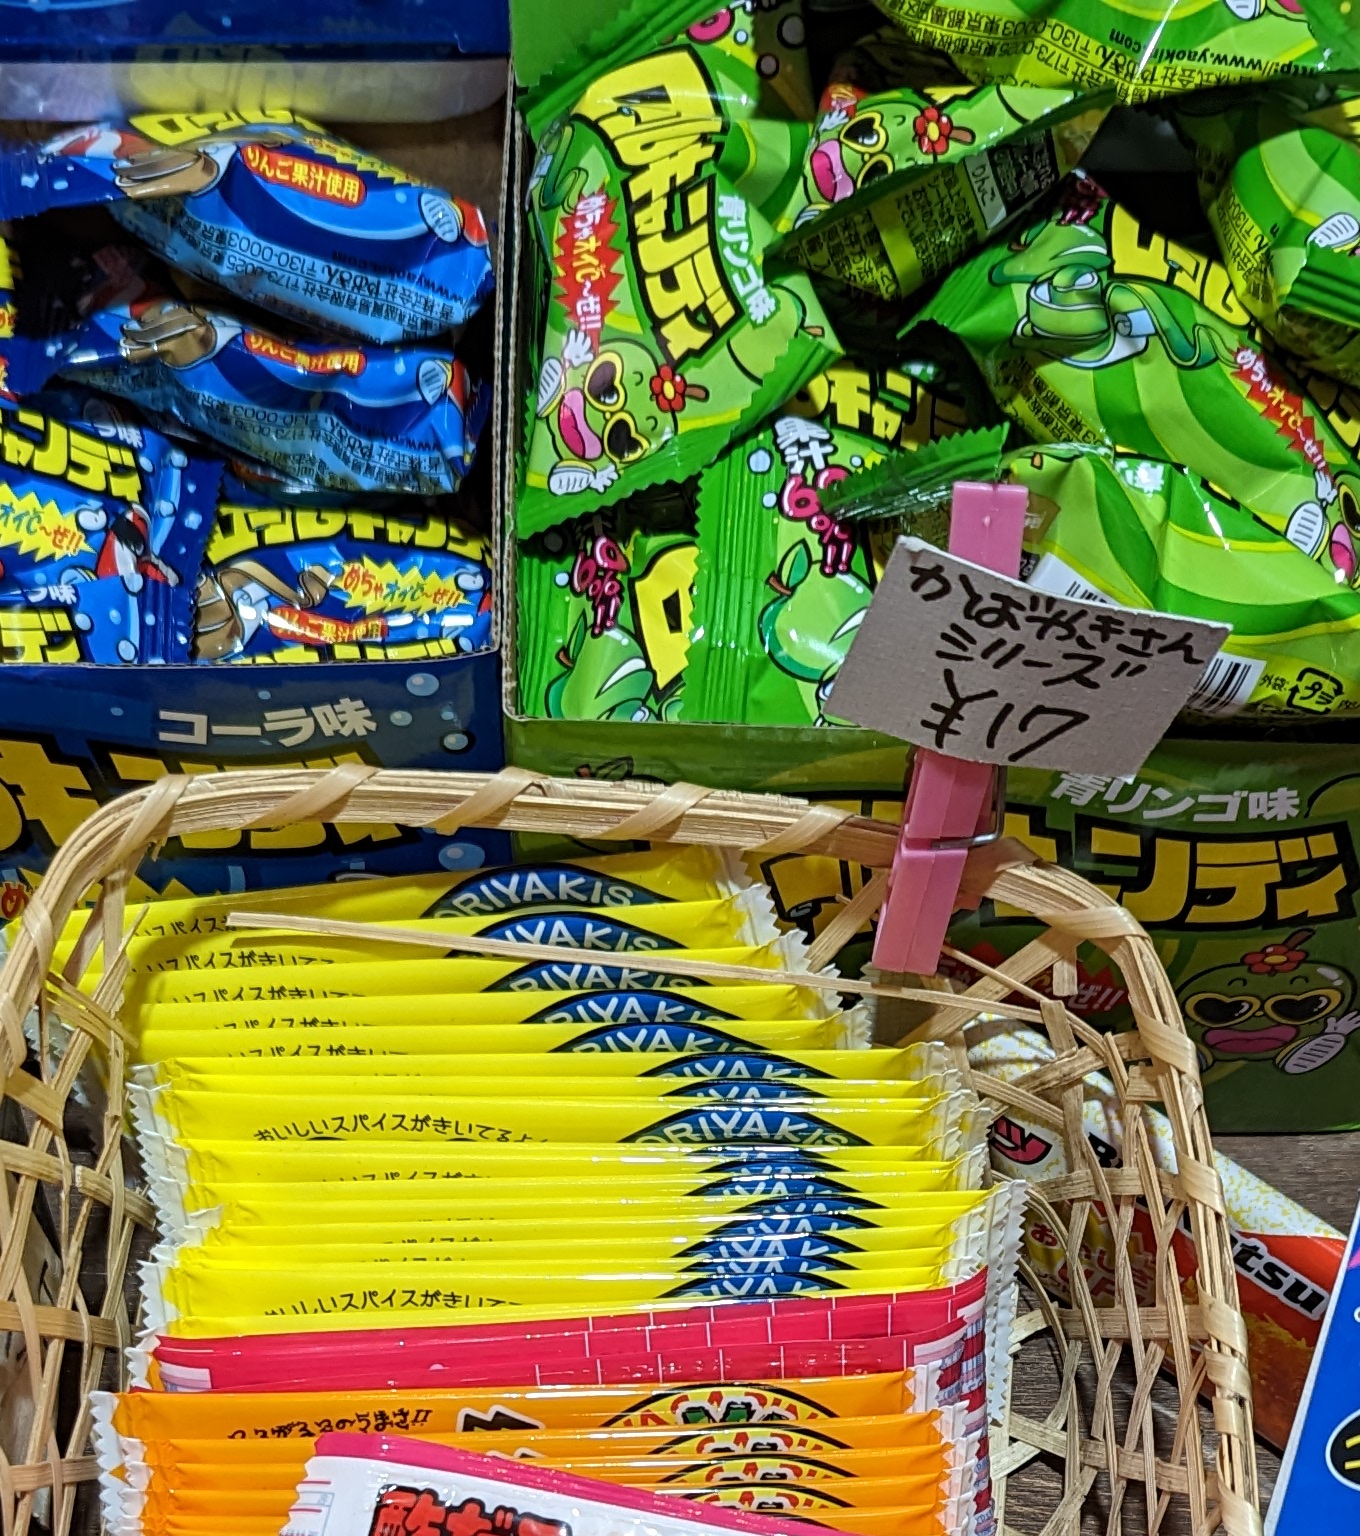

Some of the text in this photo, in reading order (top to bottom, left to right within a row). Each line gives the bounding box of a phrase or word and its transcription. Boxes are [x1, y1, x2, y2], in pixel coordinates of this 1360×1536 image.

[244, 145, 363, 205] りんご果汁使用
[158, 698, 378, 746] コーラ味
[1050, 770, 1302, 824] 青リンゴ味
